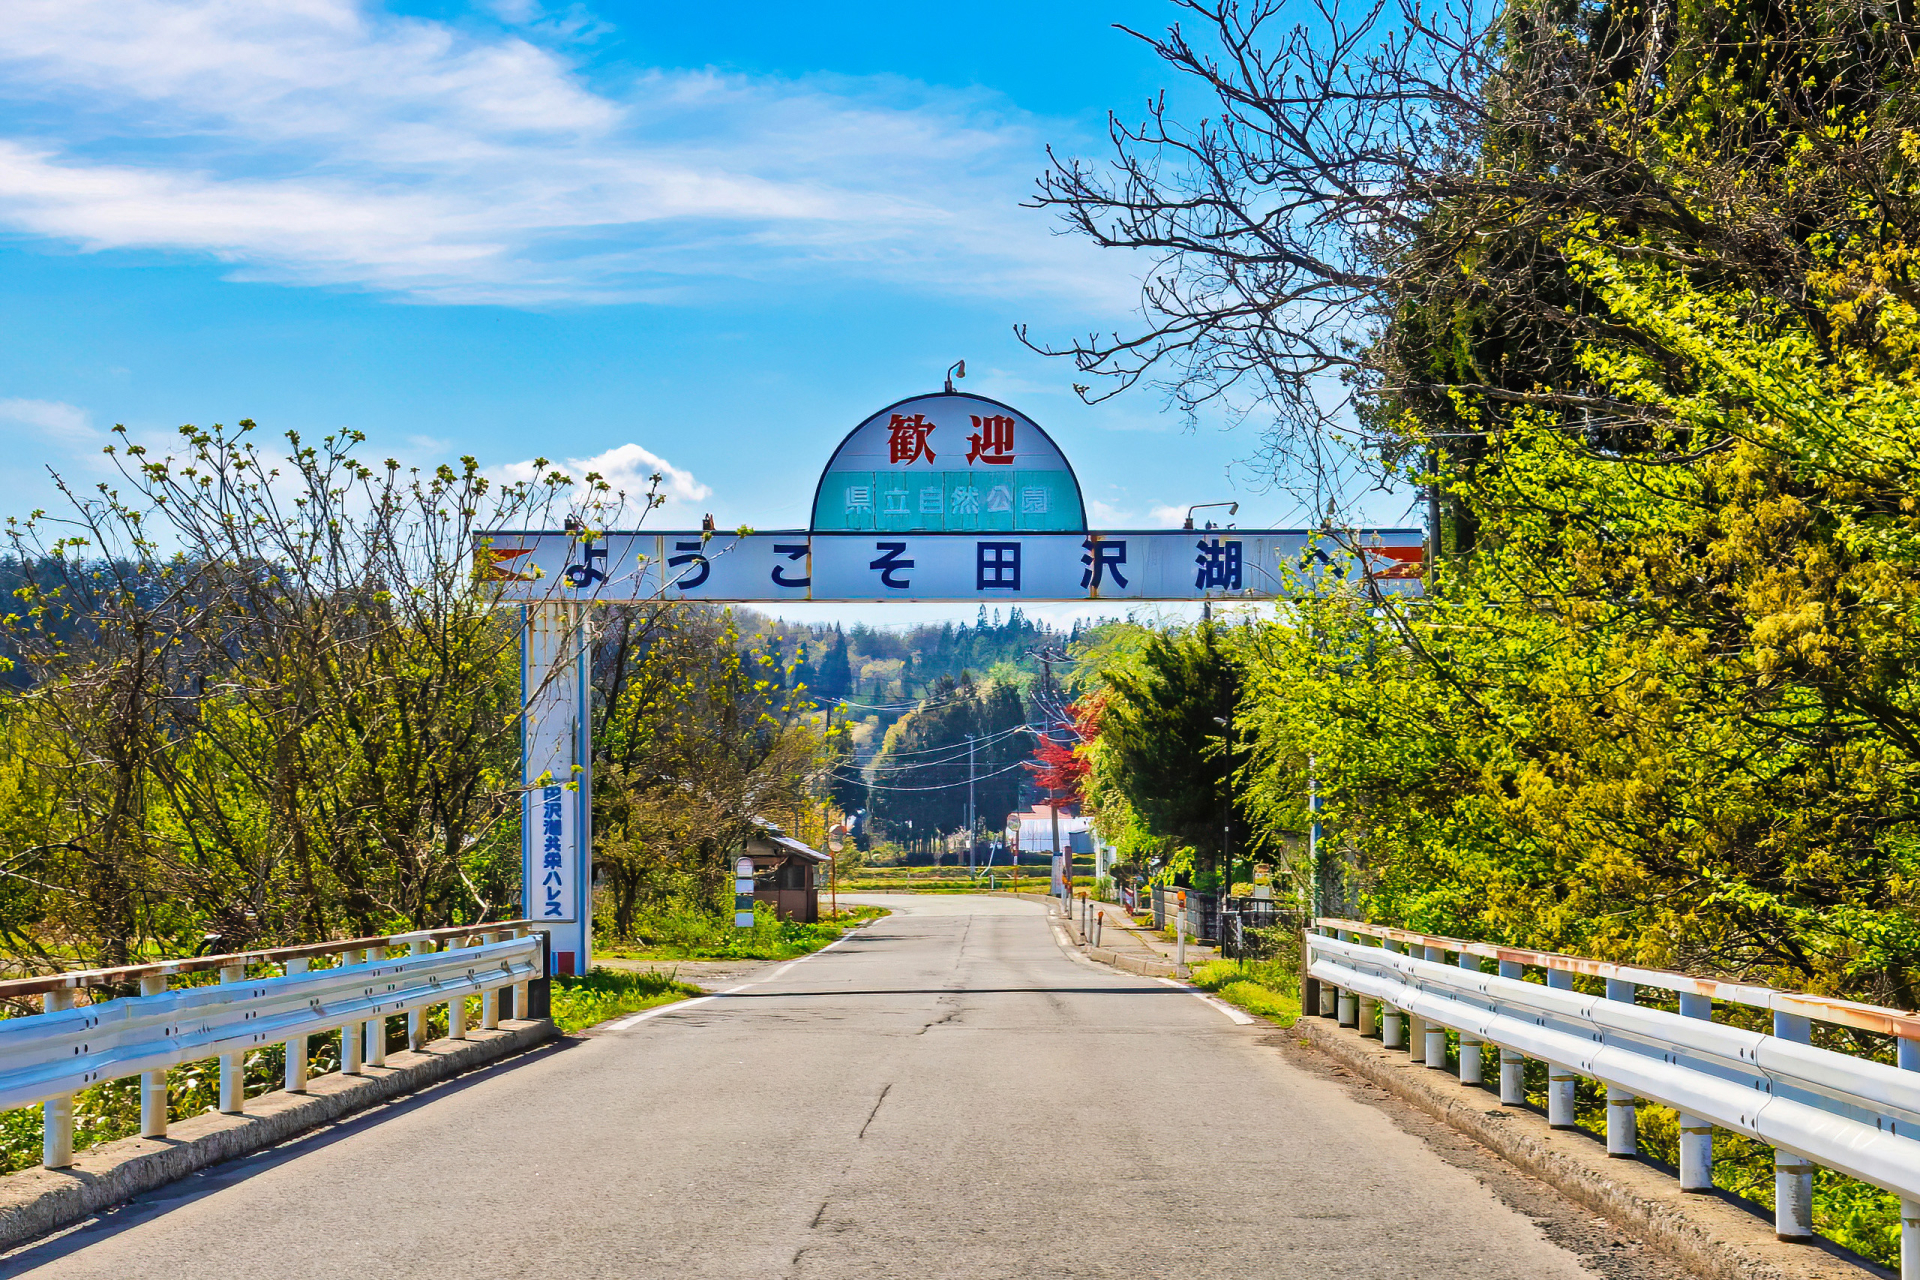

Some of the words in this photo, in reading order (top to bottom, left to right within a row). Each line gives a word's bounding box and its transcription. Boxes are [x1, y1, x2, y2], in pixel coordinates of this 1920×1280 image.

[887, 414, 1015, 466] 歓迎
[845, 486, 1048, 515] 県立自然公園
